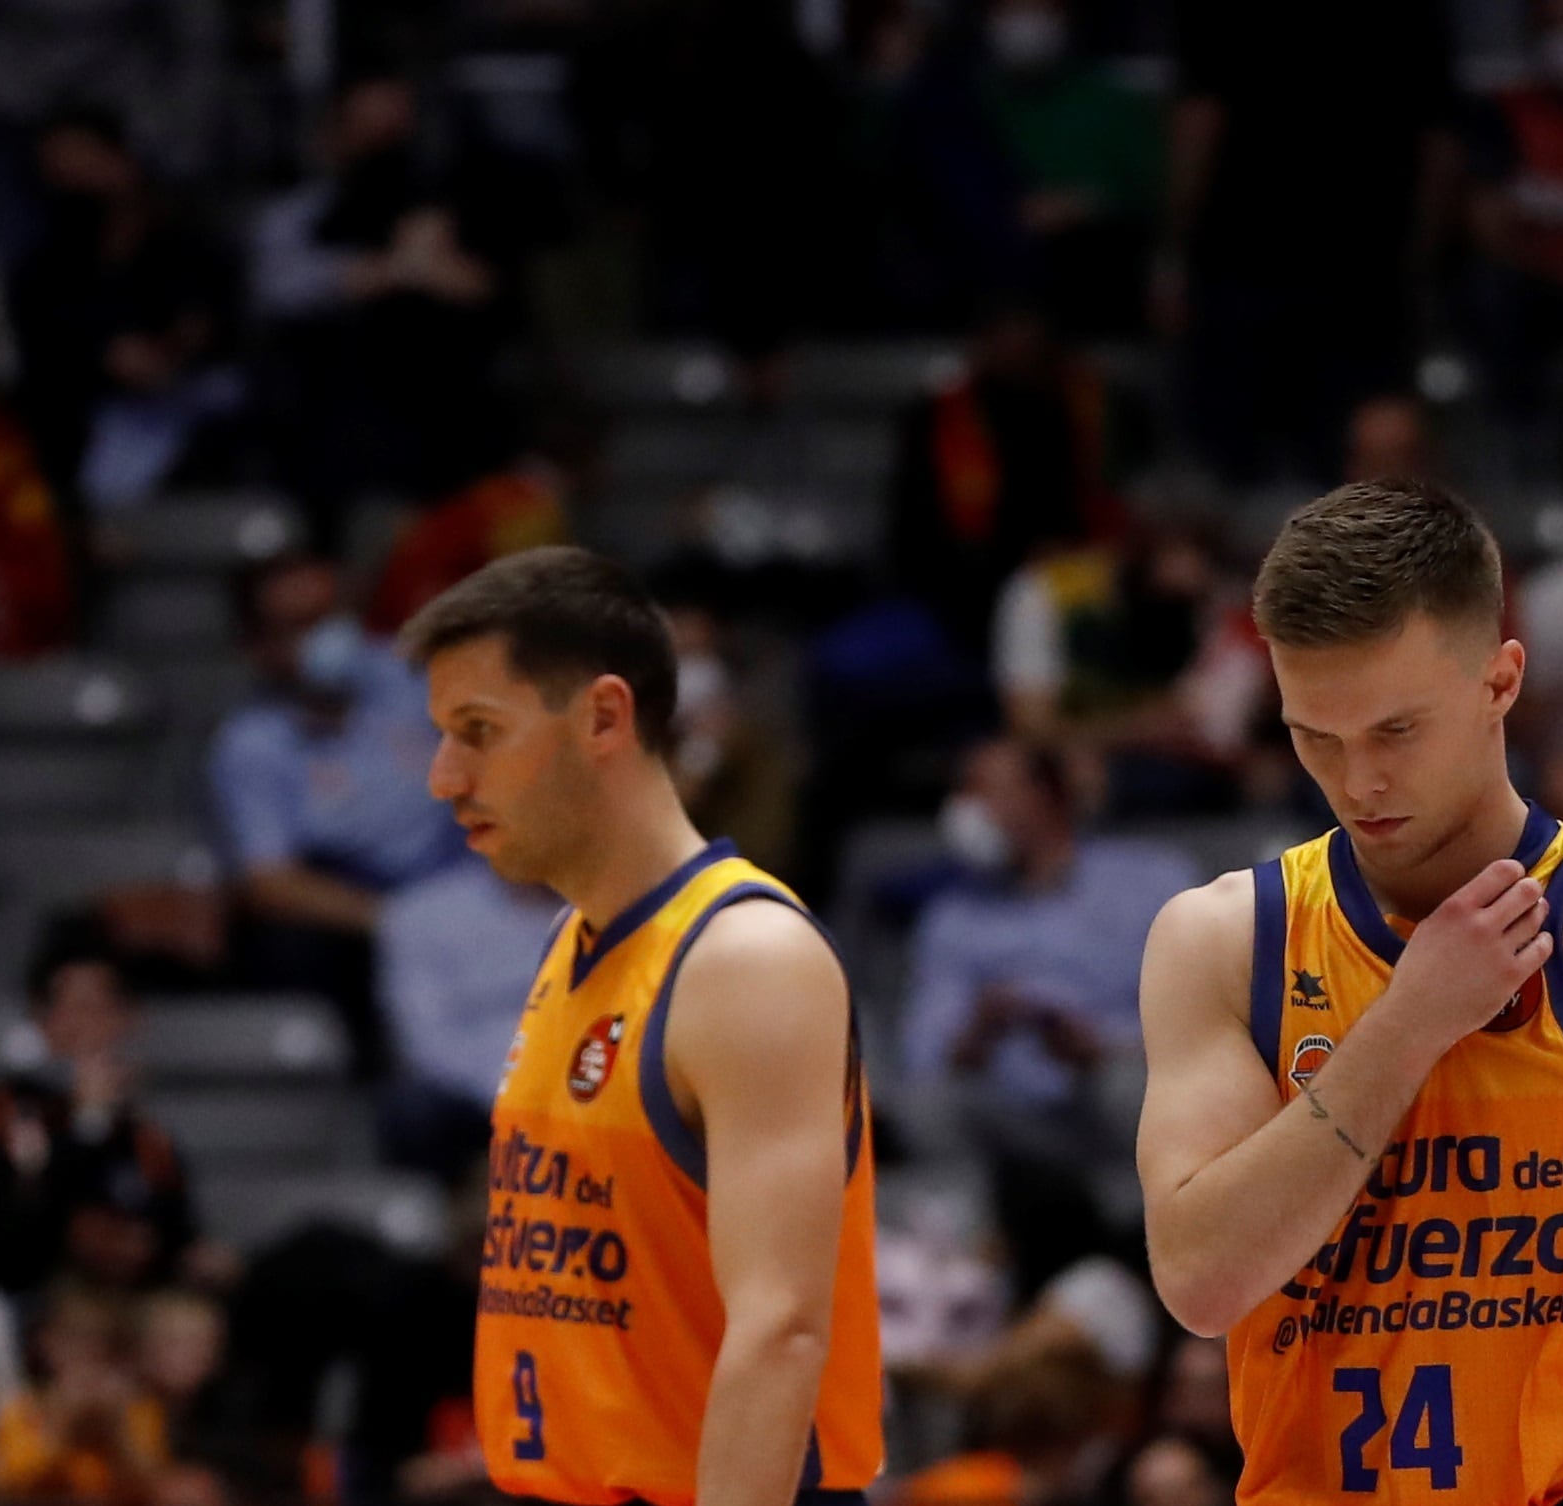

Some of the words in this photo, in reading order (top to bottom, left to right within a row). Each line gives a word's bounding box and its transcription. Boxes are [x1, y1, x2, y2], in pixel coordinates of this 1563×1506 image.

[1366, 1135, 1501, 1198] tura
[512, 1350, 545, 1461] 9
[1333, 1364, 1463, 1492] 24
